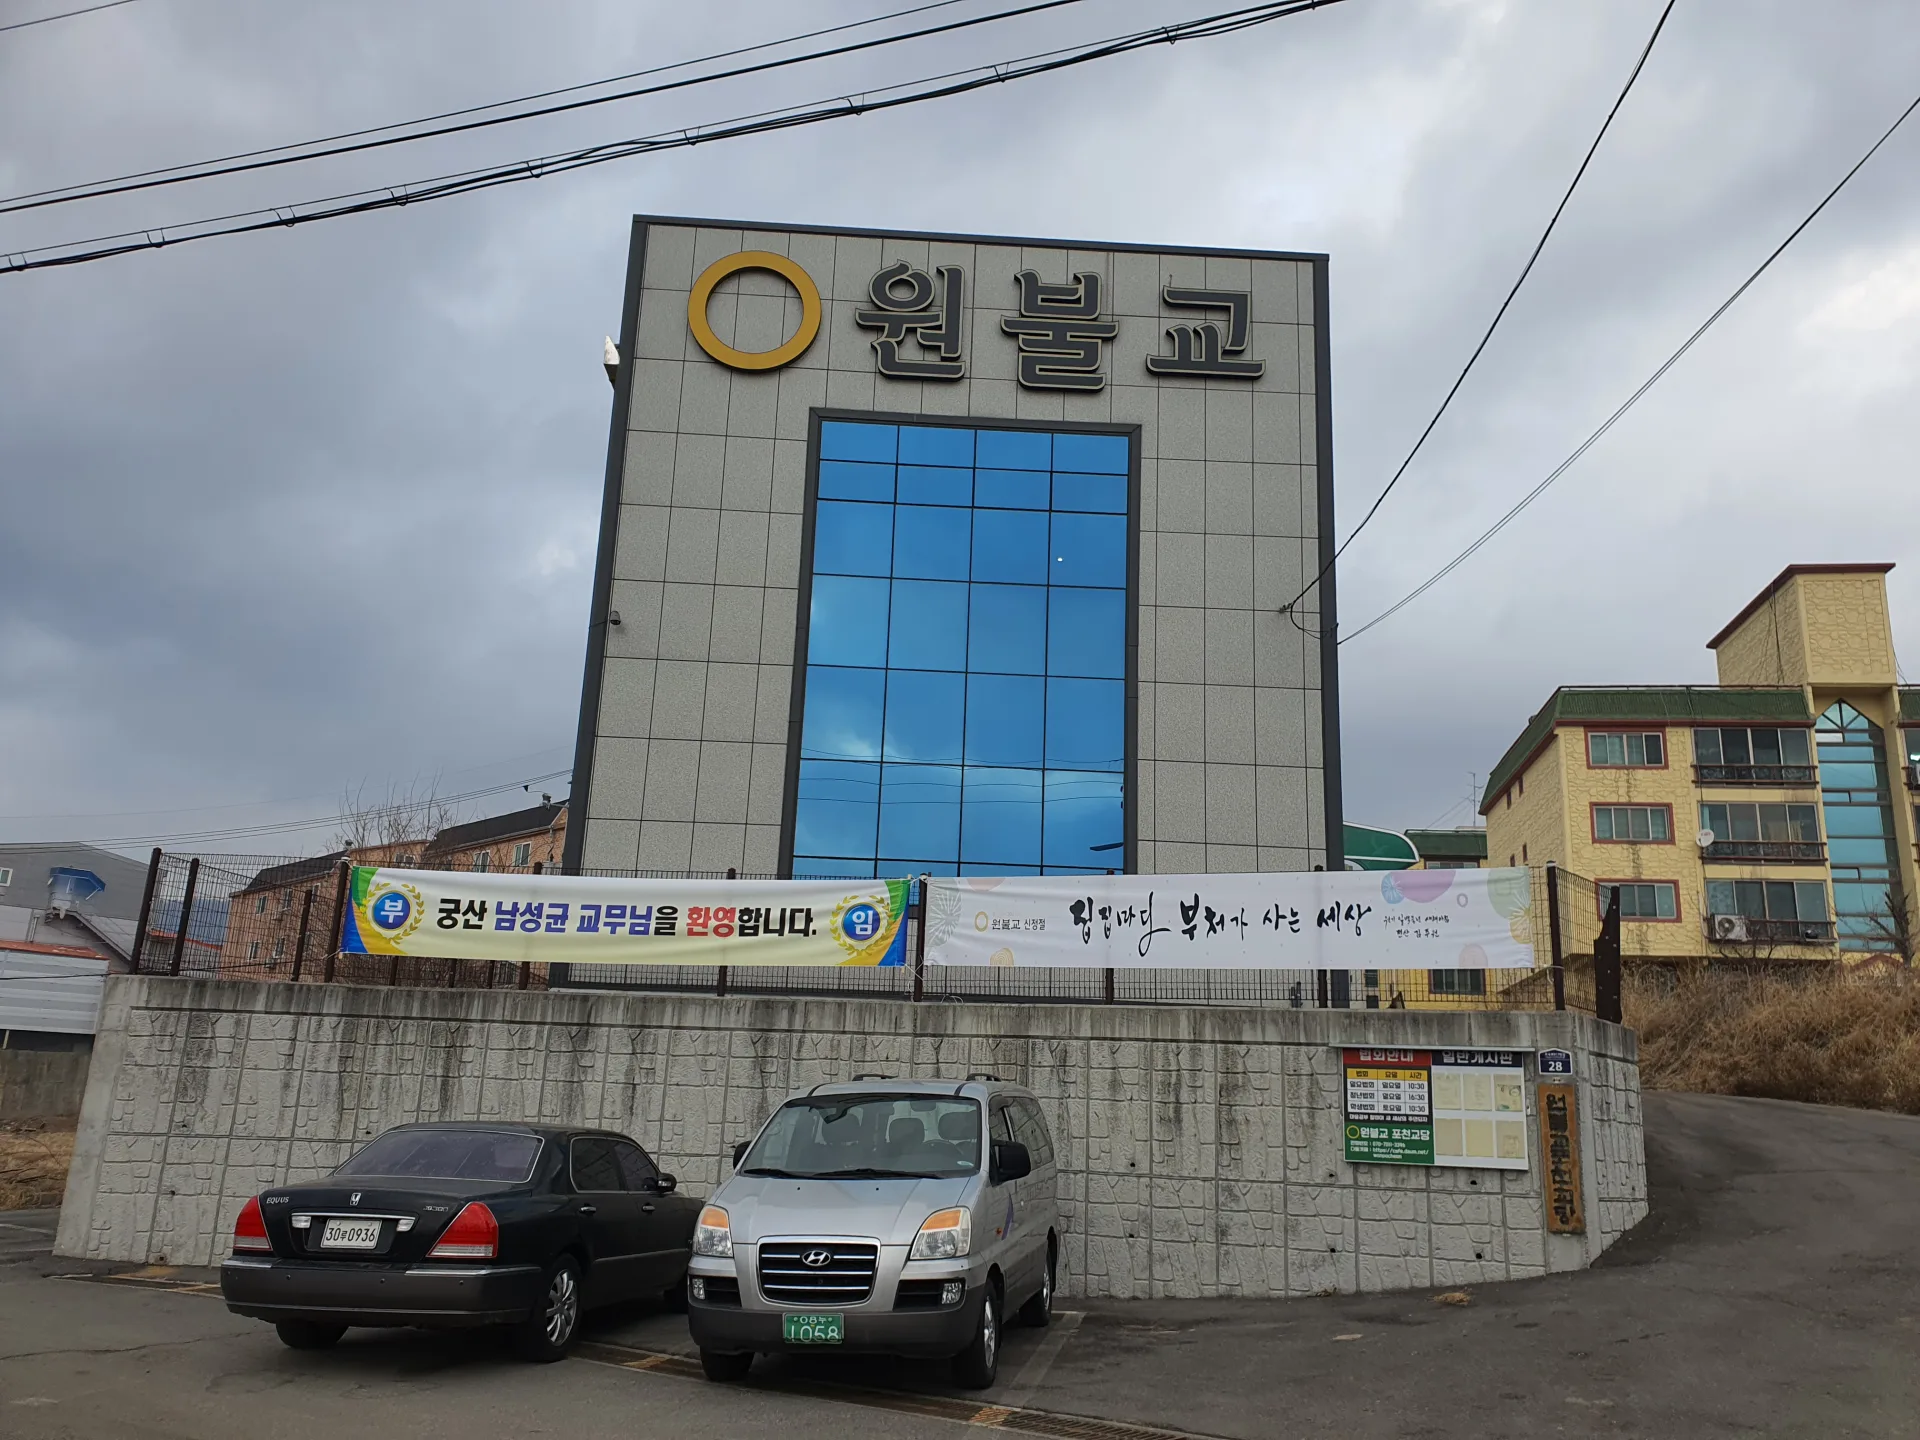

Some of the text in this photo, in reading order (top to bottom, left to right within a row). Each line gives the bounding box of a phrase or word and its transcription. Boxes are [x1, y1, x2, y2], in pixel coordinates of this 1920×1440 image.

[855, 259, 1267, 394] 원불교
[380, 898, 874, 938] 부 궁산 남성균 교무님을 환영합니다. 임
[991, 918, 1046, 931] 원불교 신정절
[1069, 891, 1372, 957] 집집마다 부처가 사는 세상
[1442, 1051, 1513, 1065] 일반게시판
[1548, 1061, 1563, 1071] 28
[1360, 1127, 1430, 1141] 원불교 포천교당
[266, 1196, 289, 1204] EQUUS
[325, 1227, 376, 1243] 30루0936
[799, 1316, 827, 1324] 08누
[791, 1325, 839, 1342] 1058
